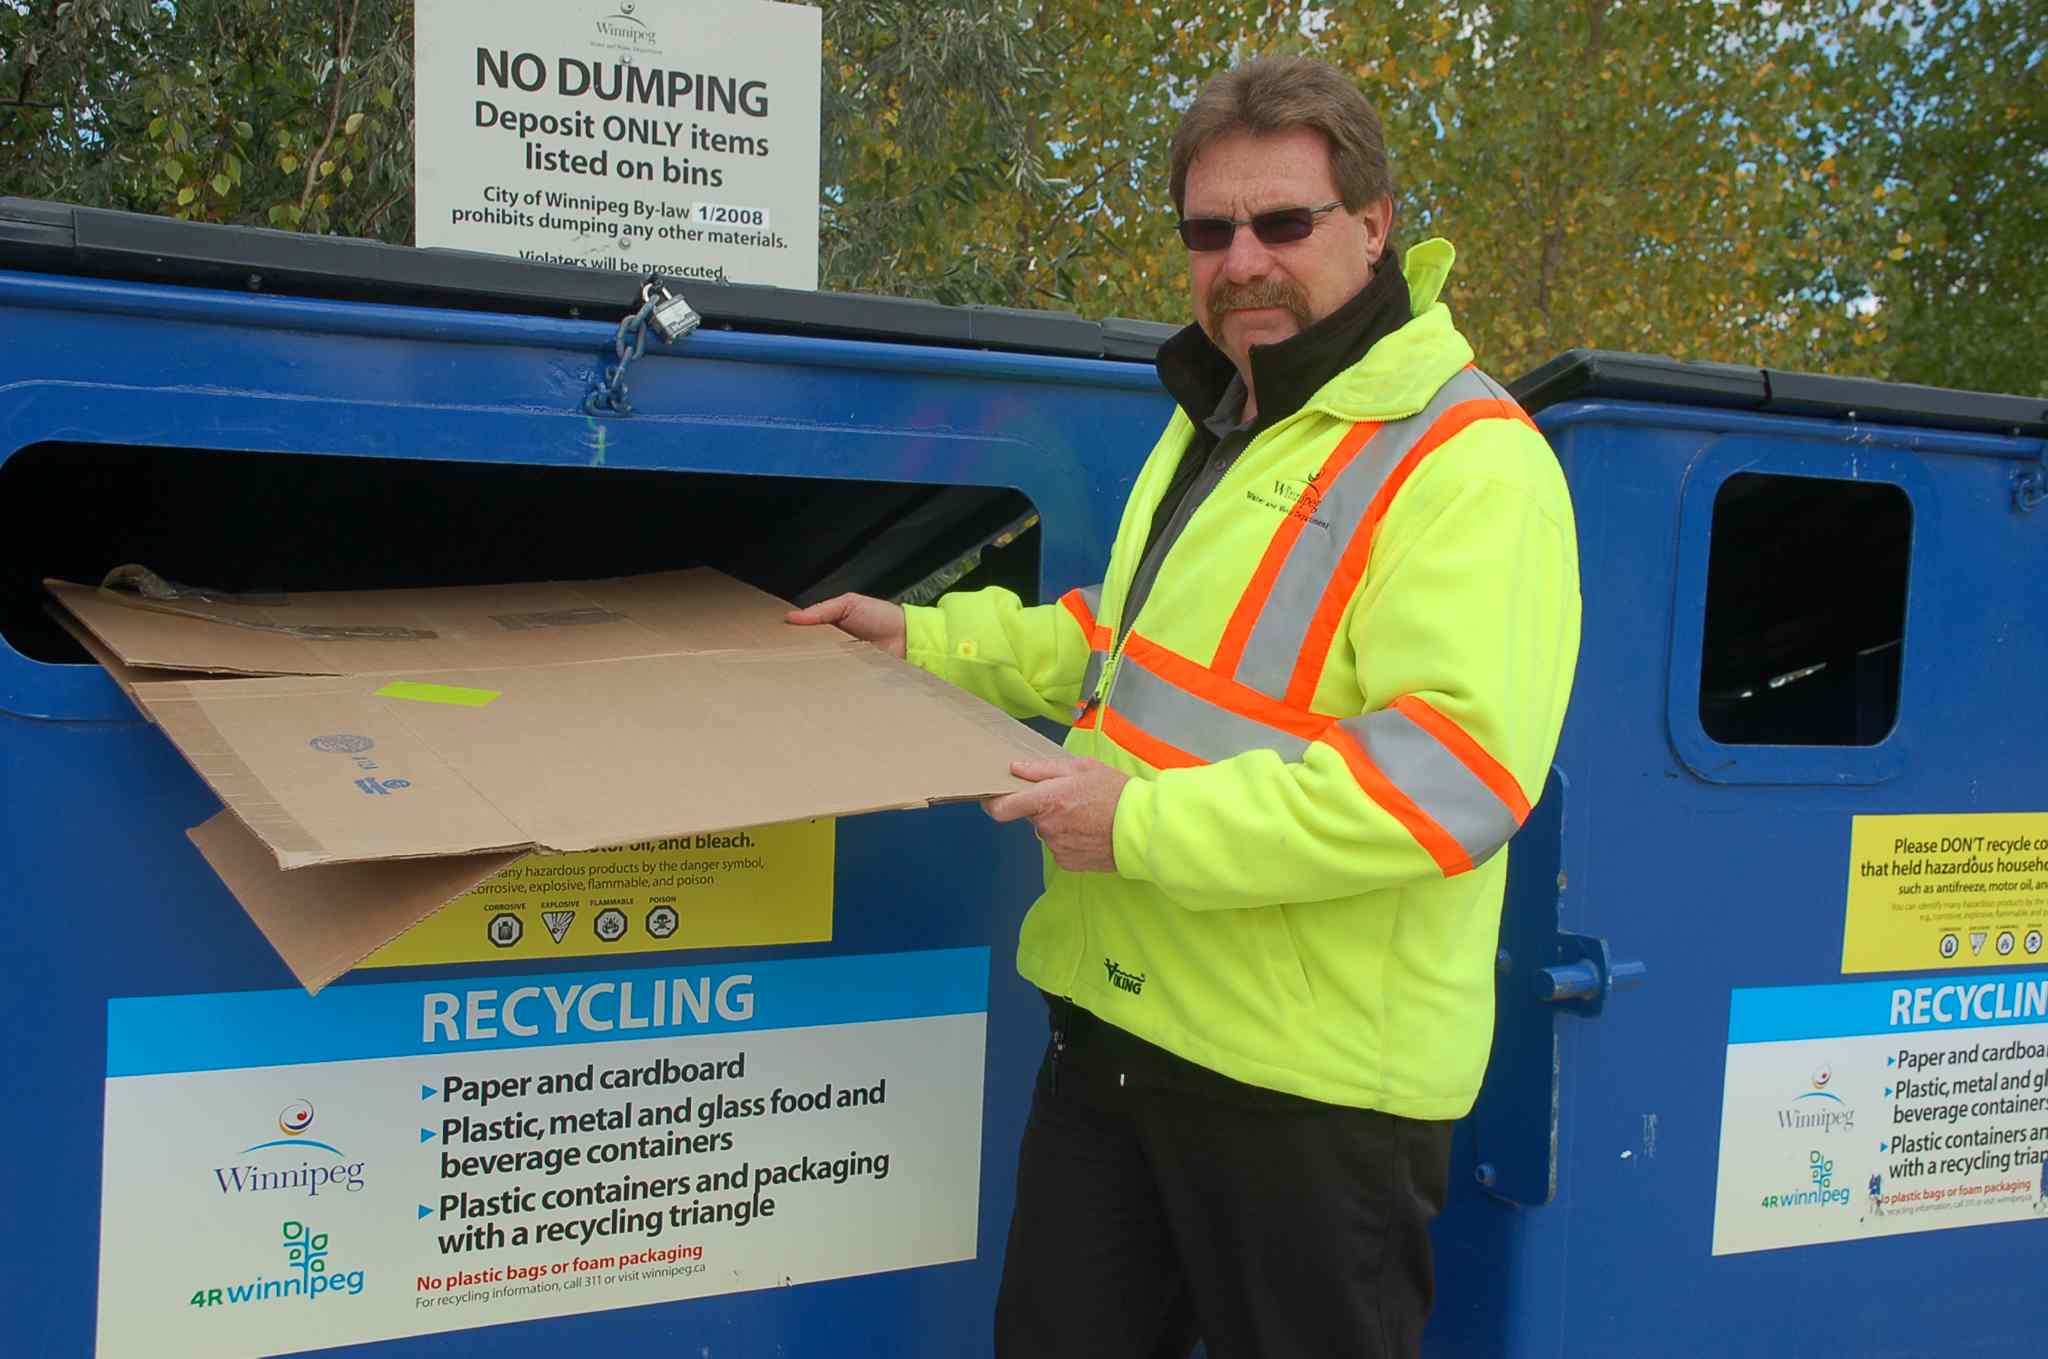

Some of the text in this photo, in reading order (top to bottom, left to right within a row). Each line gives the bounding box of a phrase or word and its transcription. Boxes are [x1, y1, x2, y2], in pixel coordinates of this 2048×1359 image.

[596, 21, 657, 47] Winnipeg
[476, 47, 769, 118] NO DUMPING
[474, 100, 769, 157] Deposit ONLY items
[526, 142, 723, 188] listed on bins
[484, 186, 763, 226] City of Winnipeg By-law 1/2008
[452, 207, 788, 249] prohibits dumping any other materials.
[590, 256, 616, 272] will
[621, 258, 639, 272] be
[642, 263, 729, 282] prosecuted.
[658, 836, 691, 851] and
[695, 832, 756, 850] bleach.
[1894, 838, 1937, 854] Please
[1940, 836, 1985, 853] DON'T
[1986, 835, 2031, 855] recycle
[497, 857, 765, 880] any hazardous products by the danger symbol,
[1861, 861, 1888, 877] that
[1892, 860, 1921, 876] held
[1925, 858, 1994, 874] hazardous
[529, 879, 586, 894] explosive,
[588, 877, 651, 890] flammable,
[652, 875, 674, 887] and
[676, 875, 714, 888] poison
[1898, 883, 1921, 895] such
[1923, 885, 1935, 894] as
[1989, 880, 2018, 892] motor
[541, 900, 580, 909] EXPLOSIVE
[648, 895, 677, 904] POISON
[1103, 958, 1145, 995] VIKING
[421, 973, 756, 1044] RECYCLING
[1889, 980, 2048, 1026] RECYCLIN
[1898, 1050, 1945, 1072] Paper
[1947, 1043, 1979, 1065] and
[443, 1052, 745, 1107] Paper and cardboard
[1895, 1077, 1950, 1099] Plastic,
[1952, 1072, 1998, 1095] metal
[2000, 1069, 2031, 1090] and
[442, 1078, 886, 1146] Plastic, metal and glass food and
[1777, 1107, 1855, 1134] Winnipeg
[1893, 1104, 1968, 1124] beverage
[441, 1127, 734, 1179] beverage containers
[1890, 1131, 1942, 1155] Plastic
[1945, 1126, 2027, 1149] containers
[213, 1161, 366, 1197] Winnipeg
[1889, 1157, 1924, 1179] with
[1927, 1161, 1937, 1175] a
[1940, 1150, 2011, 1176] recycling
[439, 1150, 890, 1222] Plastic containers and packaging
[1761, 1186, 1850, 1209] 4R winnipeg
[1891, 1191, 1921, 1206] plastic
[1923, 1188, 1946, 1201] bags
[1947, 1188, 1958, 1198] or
[1958, 1184, 1983, 1197] foam
[1984, 1179, 2032, 1195] packaging
[438, 1193, 776, 1255] with a recycling triangle
[416, 1244, 703, 1292] No plastic bags or foam packaging
[190, 1270, 365, 1308] 4R winnipeg
[415, 1263, 706, 1309] For recycling information, call 311 or visit winnipeg.ca
